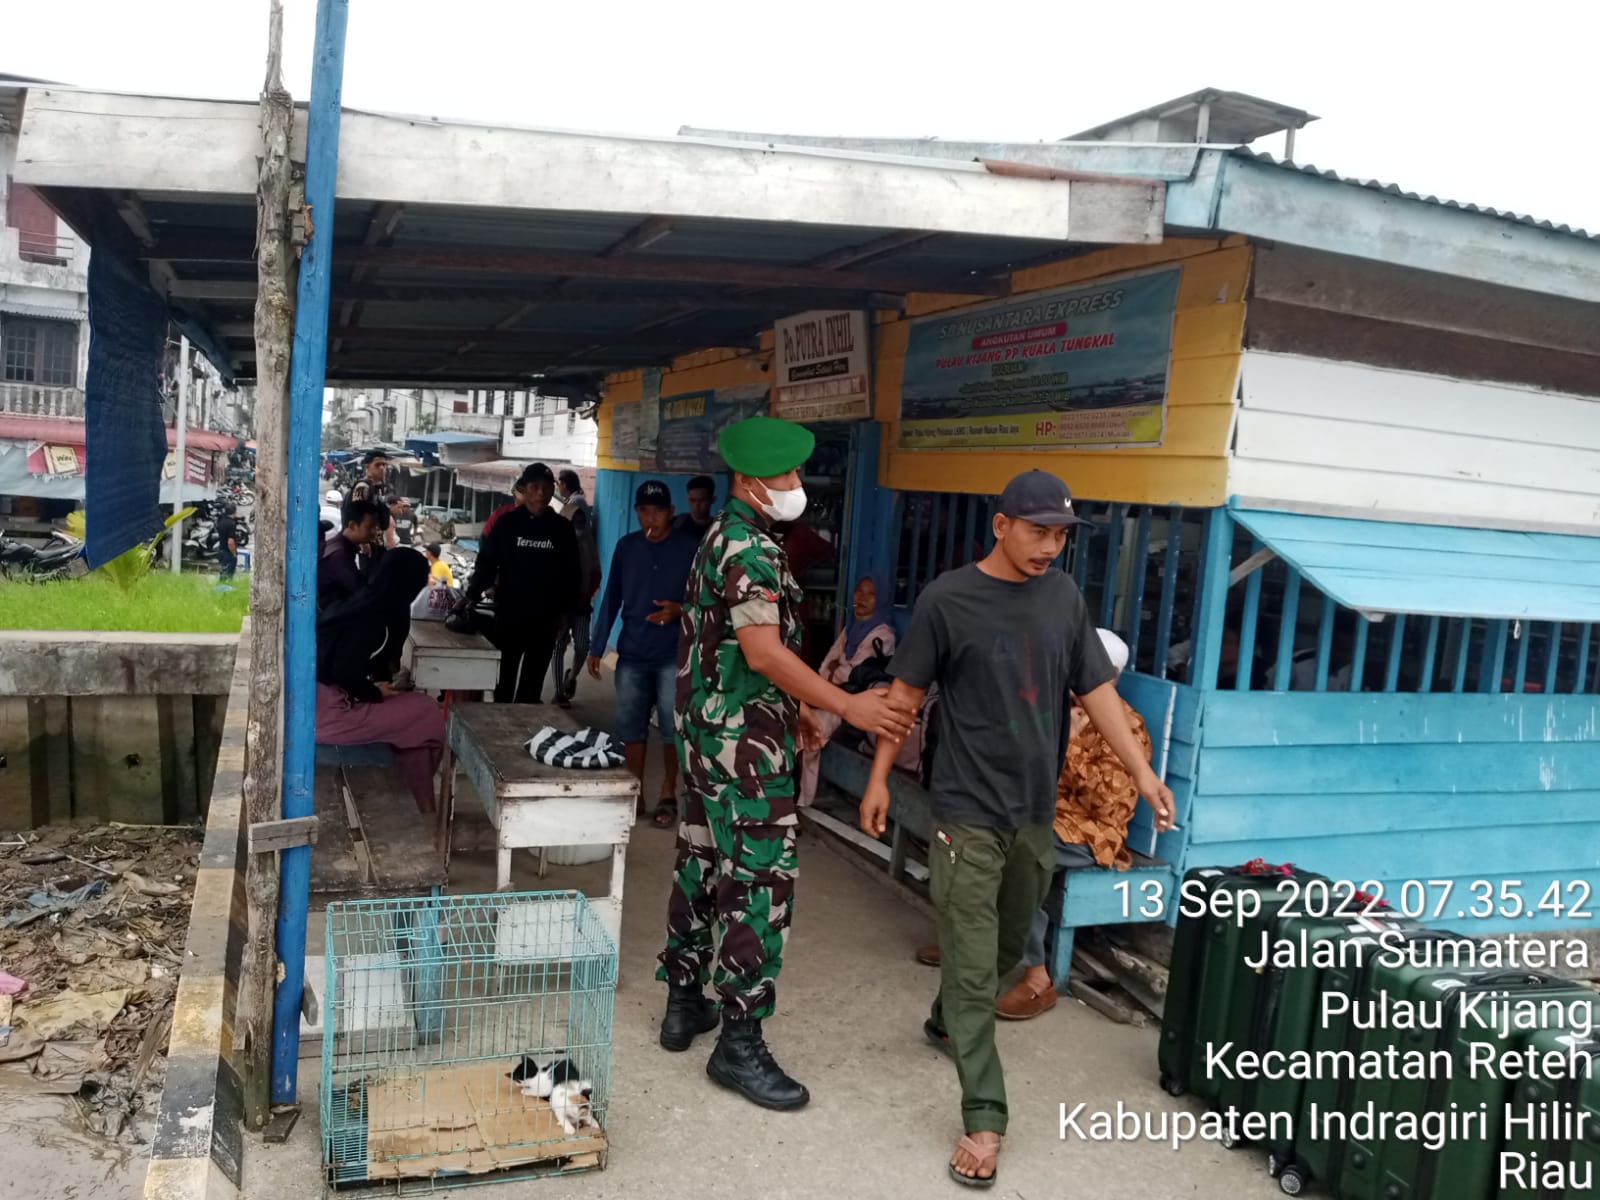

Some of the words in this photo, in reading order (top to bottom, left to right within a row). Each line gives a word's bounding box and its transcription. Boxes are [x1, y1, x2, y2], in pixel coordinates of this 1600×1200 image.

[958, 308, 1041, 335] NUSANTARA
[1045, 290, 1123, 319] EXPRESS
[980, 331, 1025, 347] ANGKUTAN
[1027, 326, 1056, 340] UMUM
[966, 350, 1001, 366] KIJANG
[1005, 346, 1018, 360] PP
[1022, 341, 1056, 358] KUALA
[1061, 333, 1115, 352] TUNGKAL
[1035, 420, 1056, 437] HP:
[516, 536, 554, 550] Terserah.
